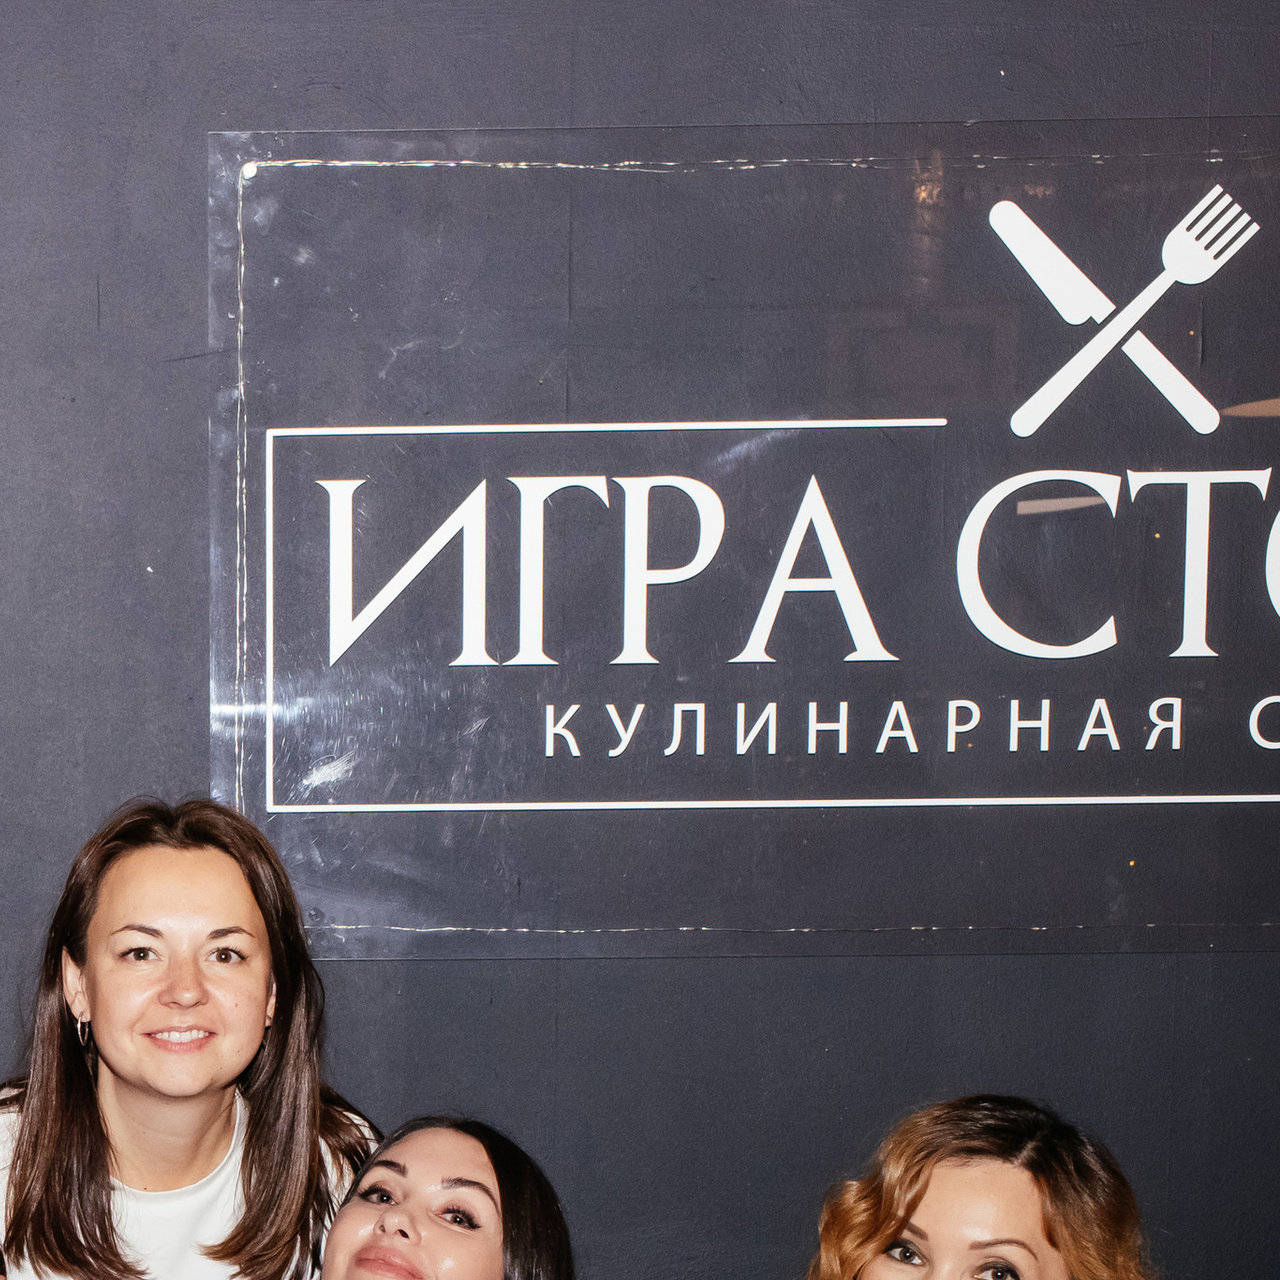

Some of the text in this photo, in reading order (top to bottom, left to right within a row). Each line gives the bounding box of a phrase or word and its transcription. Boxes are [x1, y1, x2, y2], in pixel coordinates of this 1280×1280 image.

[316, 468, 1280, 668] ИГРА СТ
[544, 697, 1187, 760] КУЛИНАРНАЯ
